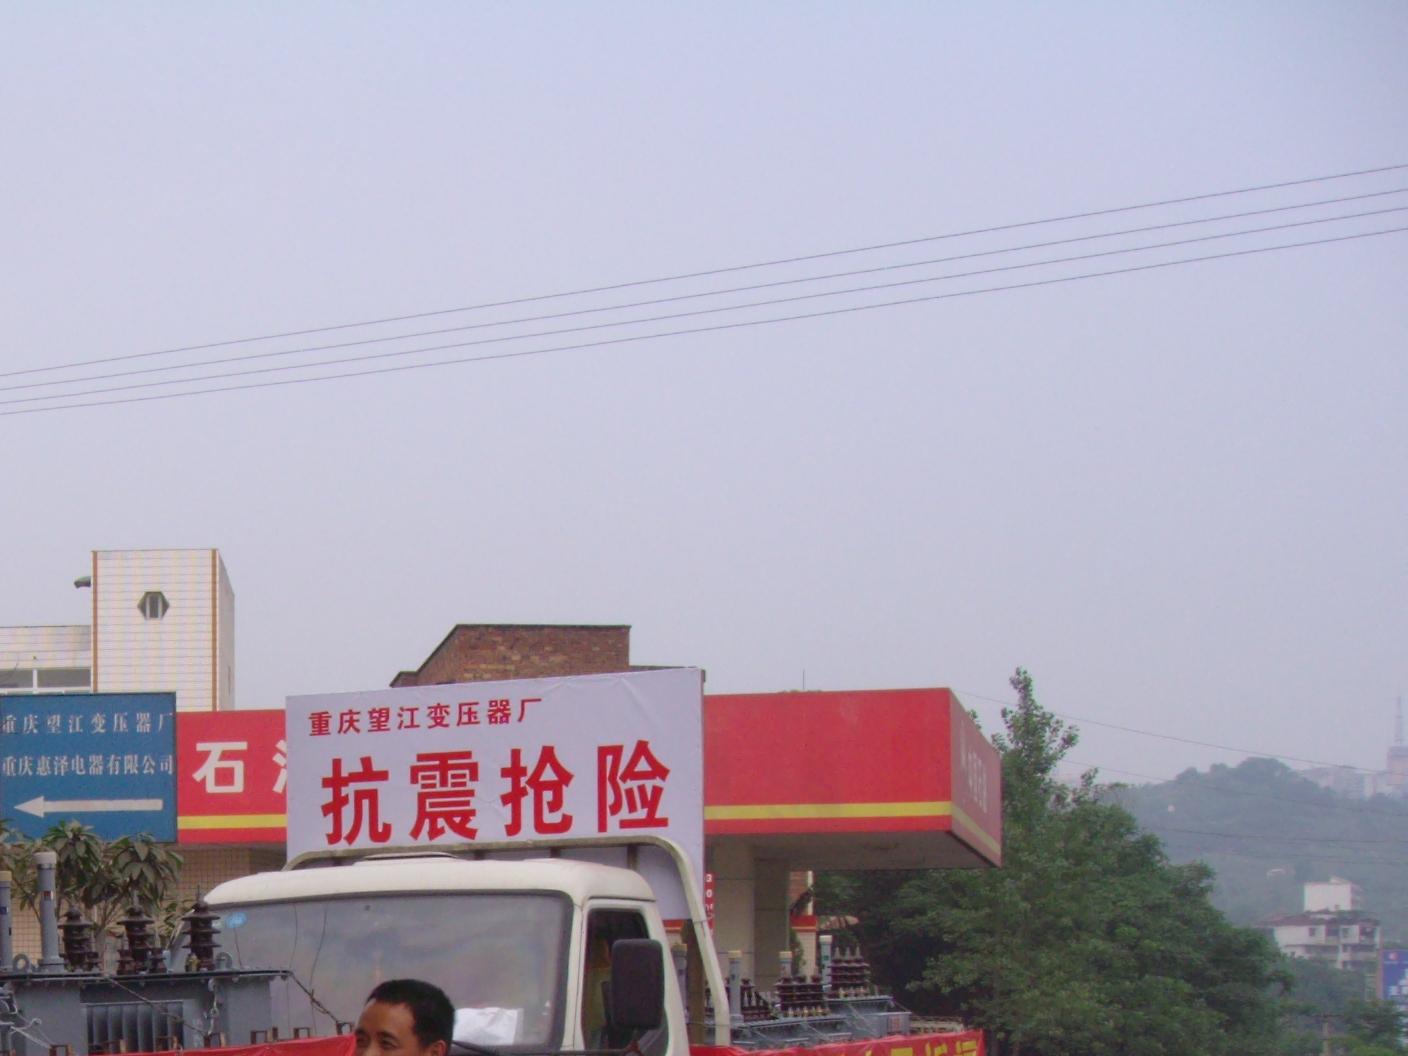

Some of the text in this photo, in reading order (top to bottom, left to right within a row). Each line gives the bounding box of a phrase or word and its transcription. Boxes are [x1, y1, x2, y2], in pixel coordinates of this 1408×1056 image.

[2, 711, 174, 735] 重庆望江变压器厂
[308, 698, 543, 738] 重庆望江变压器厂
[2, 753, 175, 777] 重庆惠泽电器有限公司
[193, 740, 287, 794] 石
[320, 739, 671, 846] 抗震抢险
